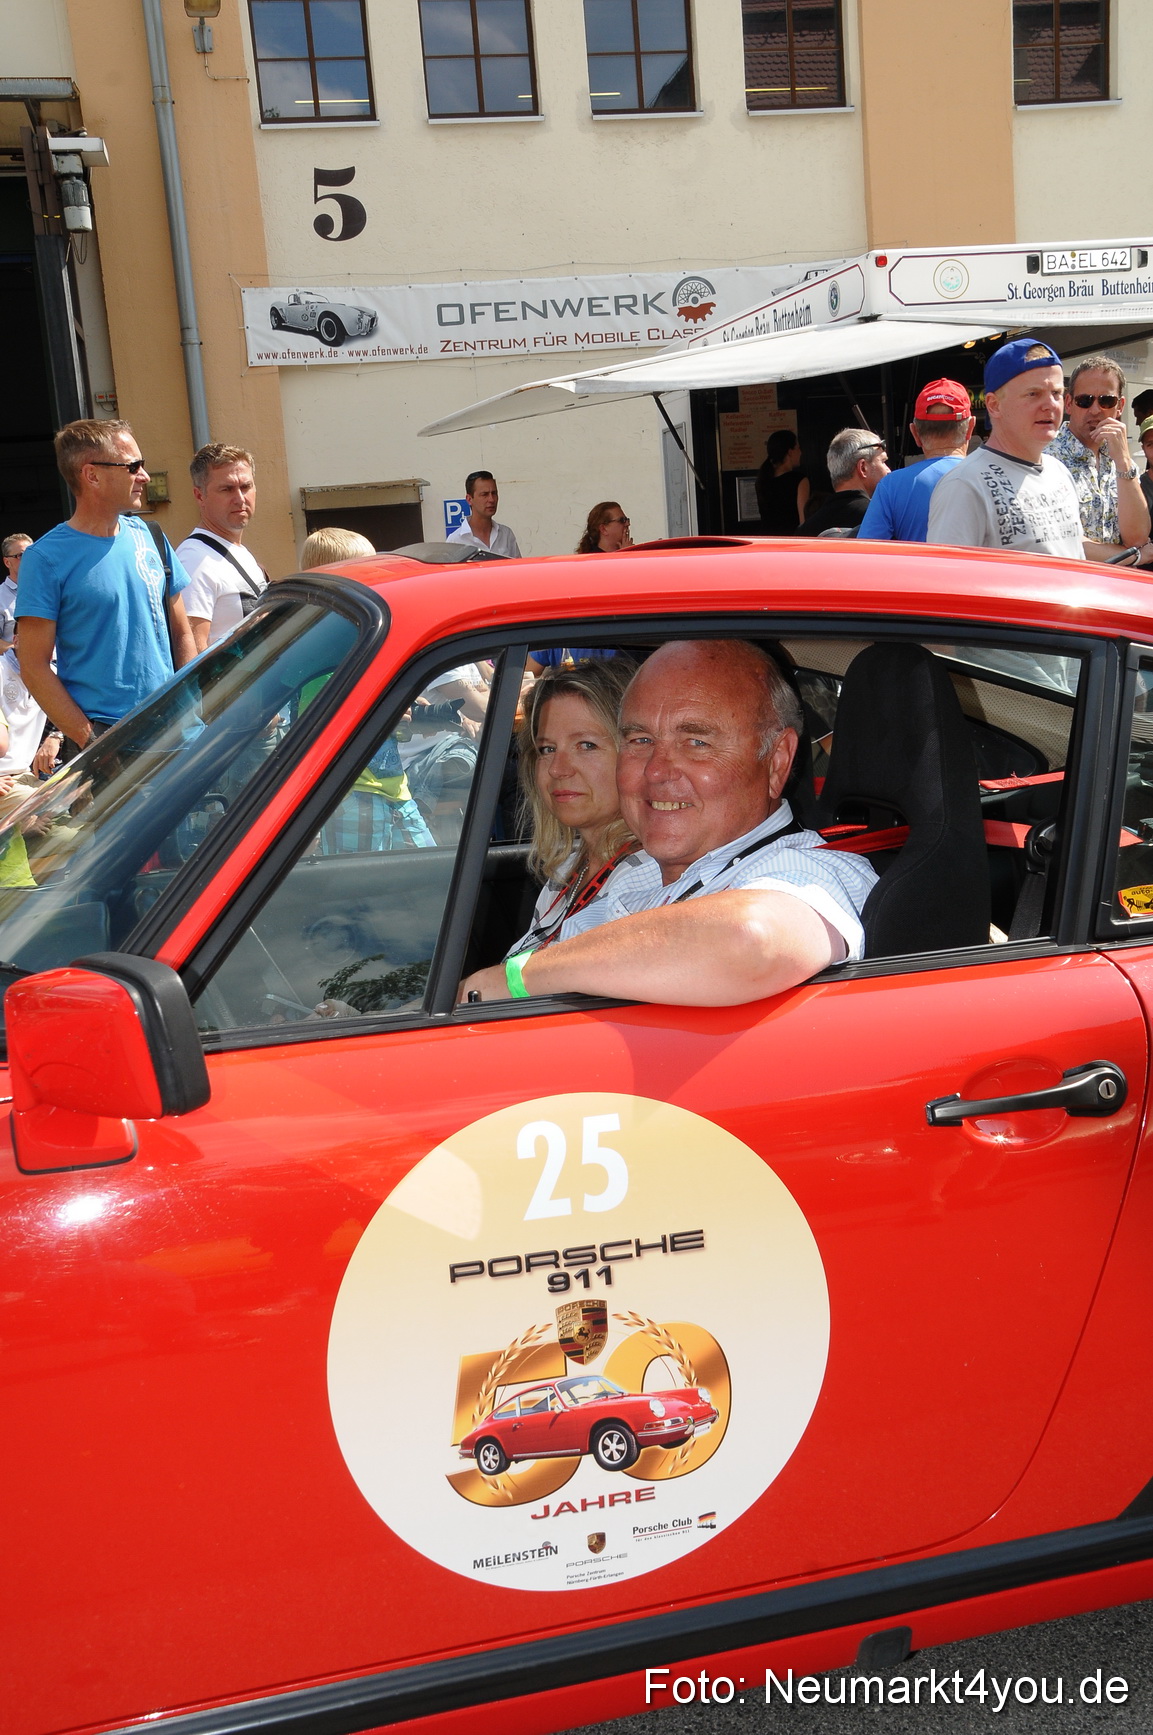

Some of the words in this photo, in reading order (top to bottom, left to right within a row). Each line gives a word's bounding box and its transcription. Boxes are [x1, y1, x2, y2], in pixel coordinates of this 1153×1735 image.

[313, 166, 367, 242] 5
[1101, 251, 1128, 267] 642
[1007, 282, 1022, 300] St.
[1023, 281, 1065, 302] Georgen
[1068, 279, 1094, 298] Bräu
[436, 291, 669, 327] OFENWERK
[772, 298, 813, 334] Buttenheim
[256, 347, 339, 361] www.ofenwerk.de
[347, 343, 429, 357] www.ofenwerk.de
[446, 502, 462, 525] P
[516, 1113, 629, 1221] 25
[450, 1229, 705, 1283] PORSCHE
[547, 1265, 613, 1293] 911
[531, 1486, 656, 1520] JAHRE
[632, 1522, 669, 1535] Porsche
[671, 1517, 693, 1528] Club
[566, 1552, 628, 1568] PORSCHE
